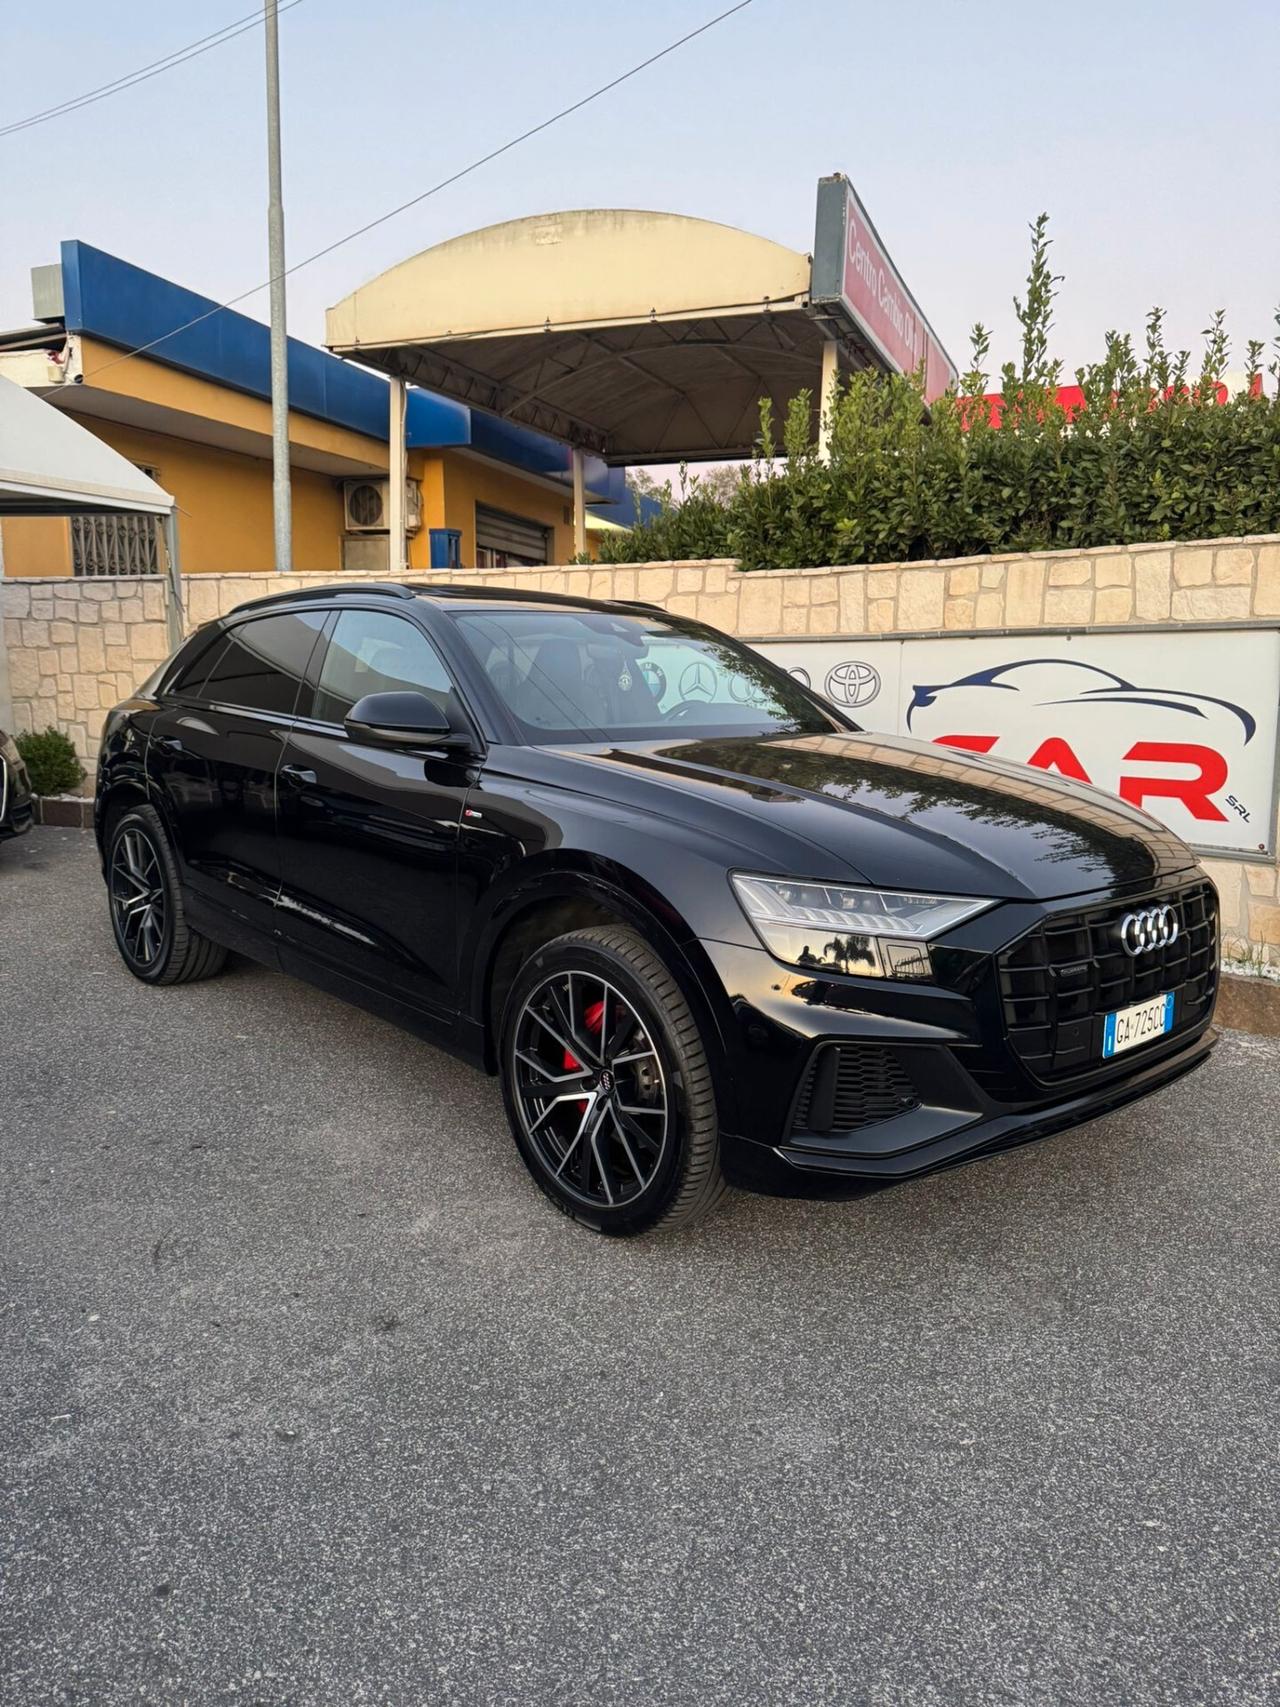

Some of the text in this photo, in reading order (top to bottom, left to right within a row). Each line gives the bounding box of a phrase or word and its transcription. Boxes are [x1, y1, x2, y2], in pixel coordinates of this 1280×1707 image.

[849, 219, 877, 297] Centro
[878, 267, 904, 337] Cambio
[1225, 794, 1251, 823] SRL
